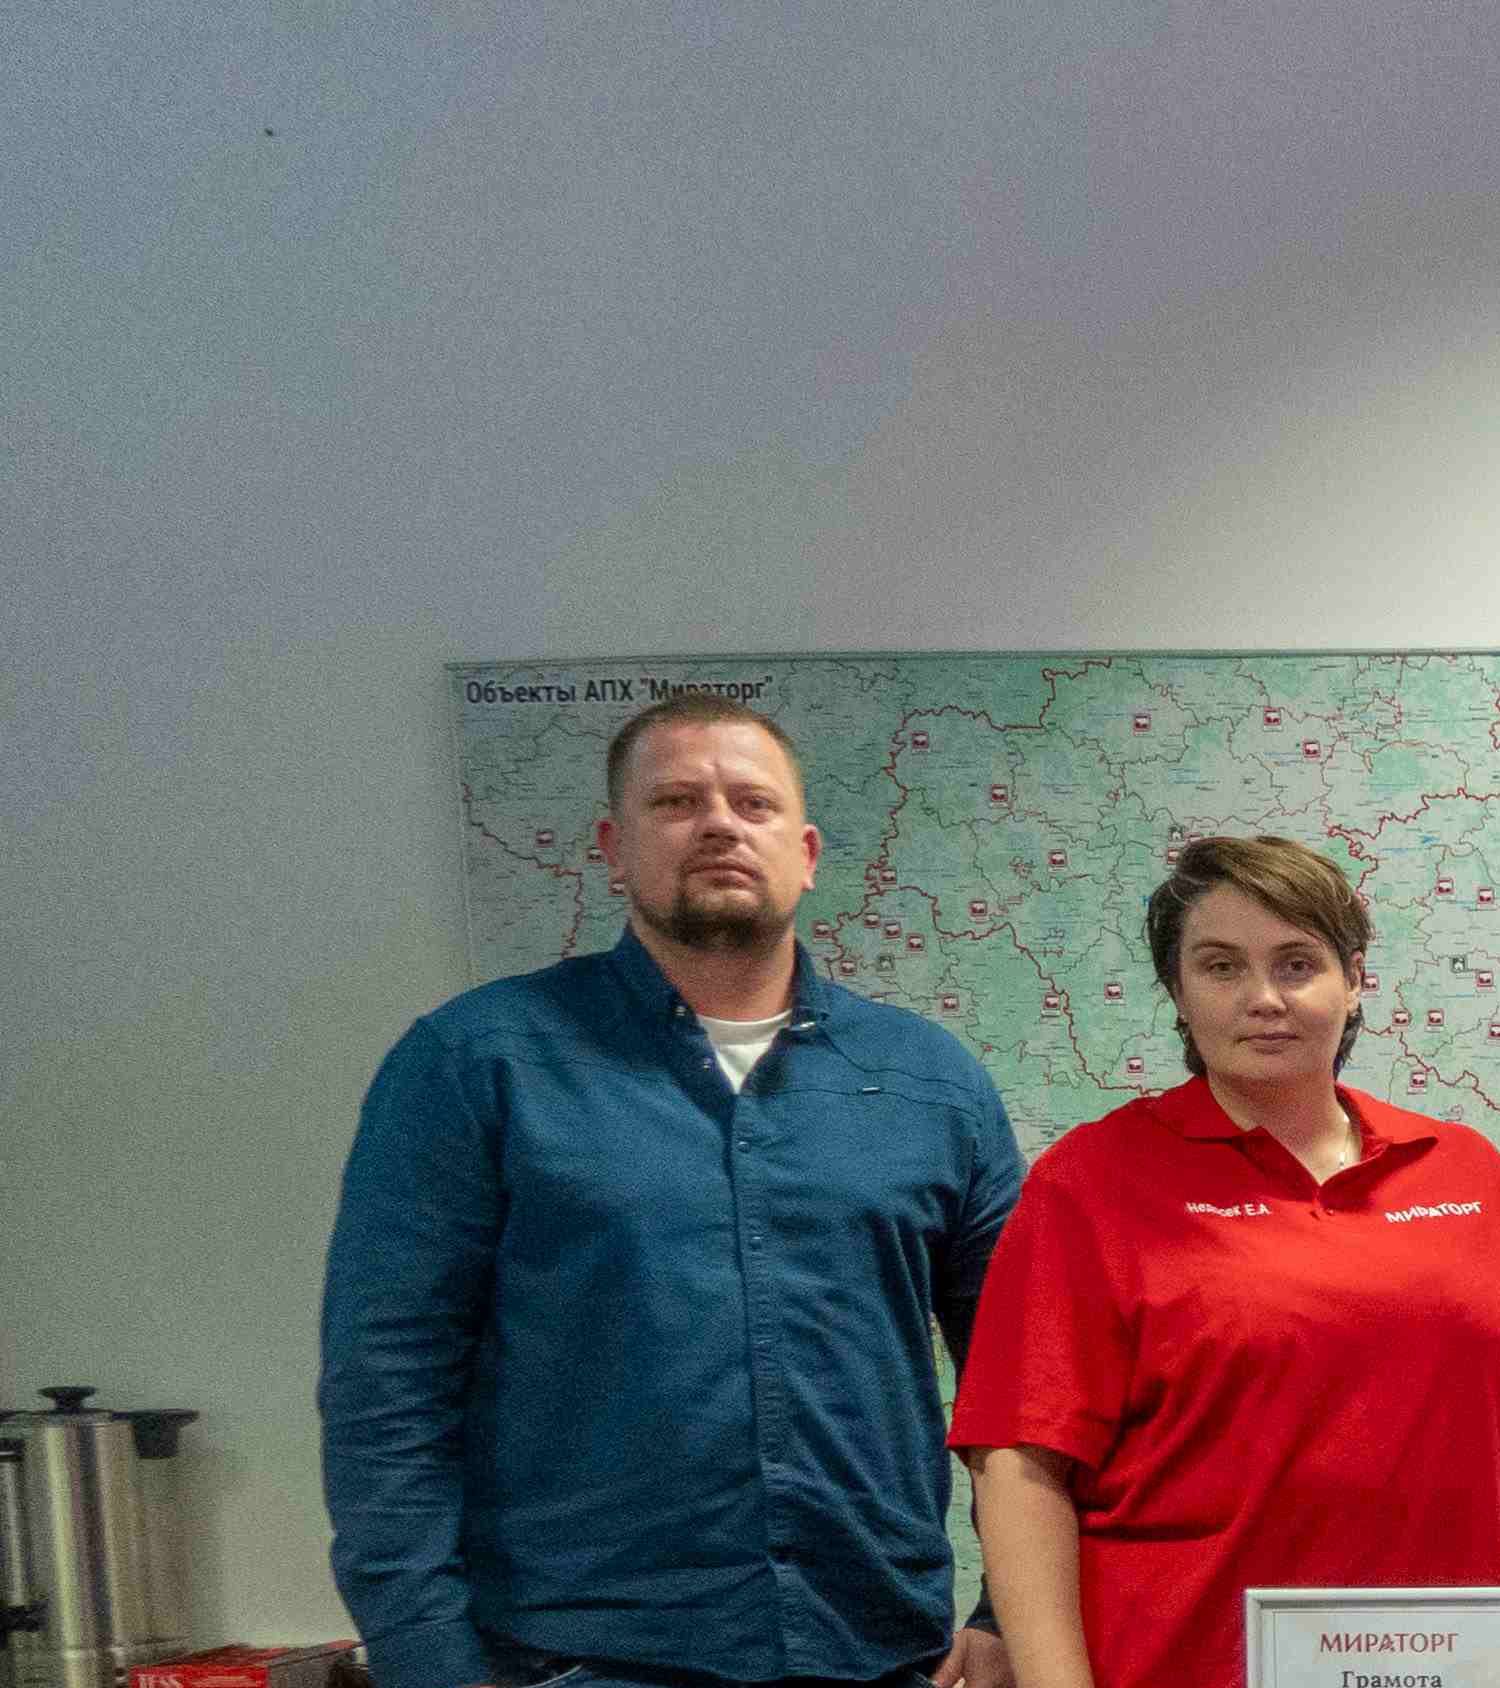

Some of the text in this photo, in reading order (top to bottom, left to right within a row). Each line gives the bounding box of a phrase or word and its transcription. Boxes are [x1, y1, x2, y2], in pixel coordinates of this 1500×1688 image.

[467, 677, 576, 704] Объекты
[584, 677, 633, 704] АПХ
[1385, 1201, 1482, 1223] МИРАТОРГ
[1320, 1633, 1458, 1652] МИРАТОРГ
